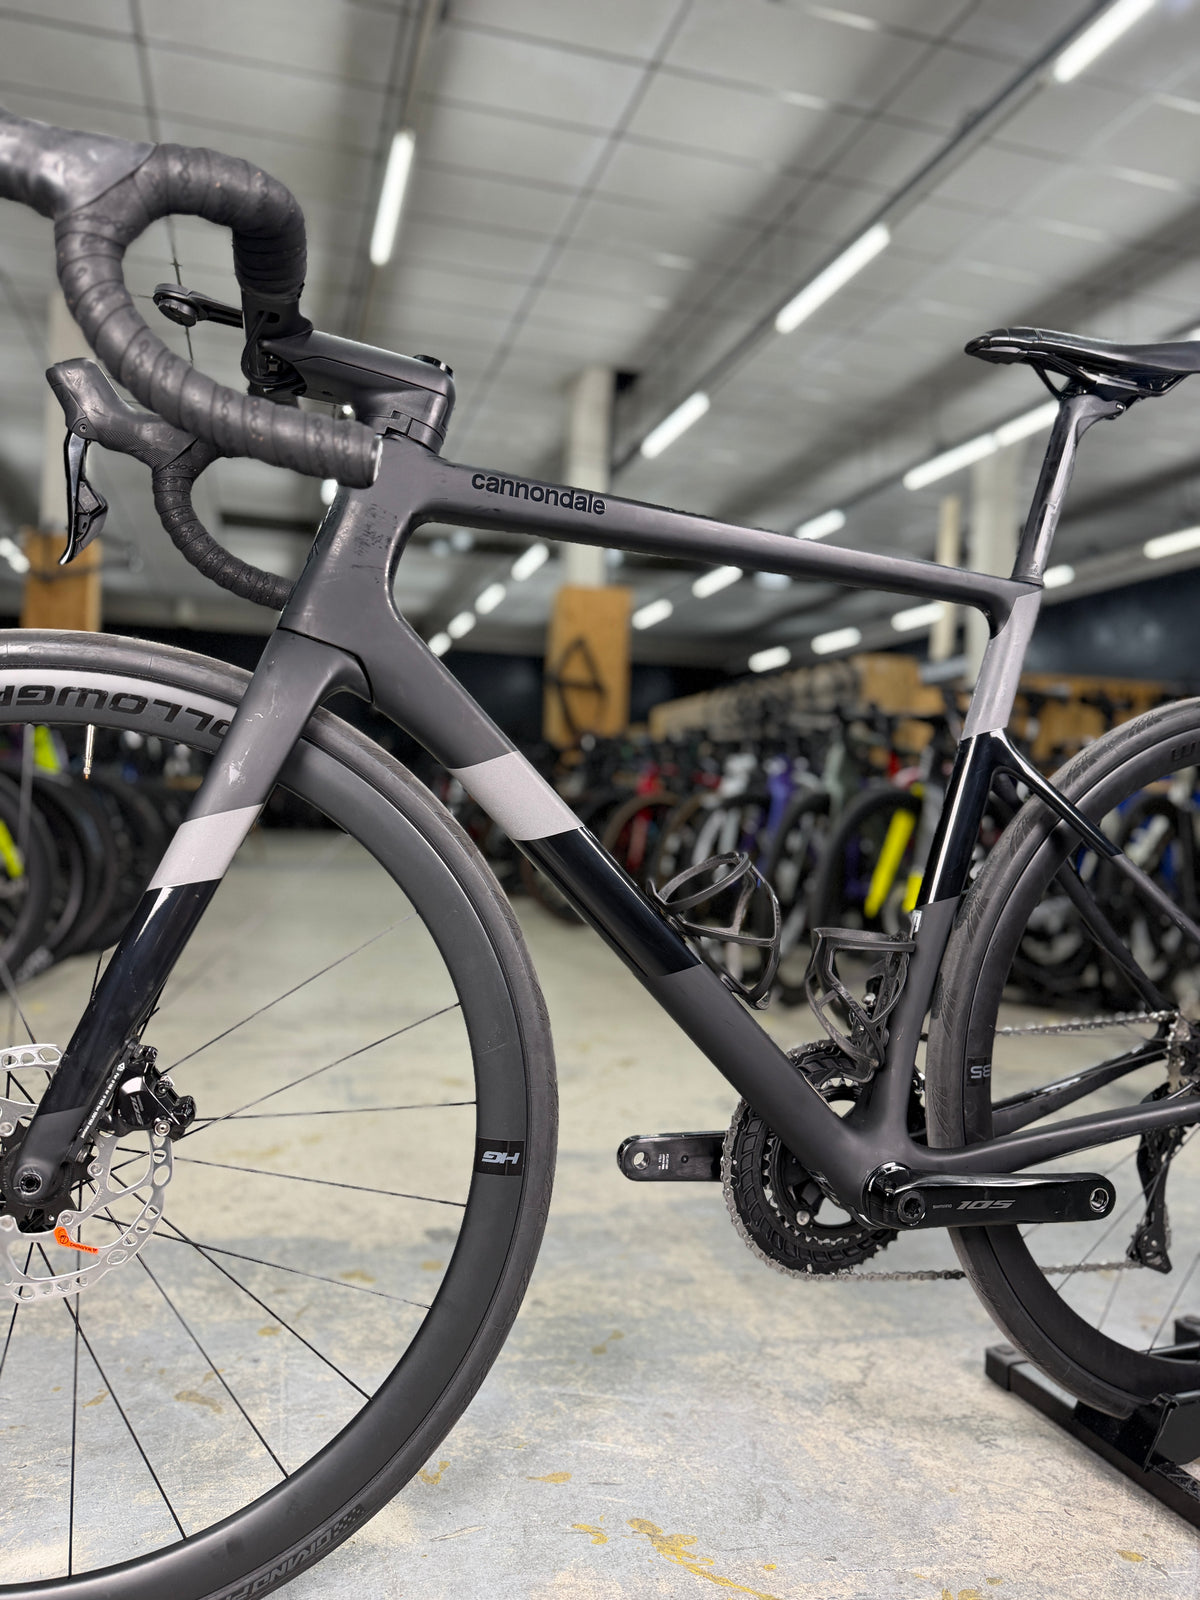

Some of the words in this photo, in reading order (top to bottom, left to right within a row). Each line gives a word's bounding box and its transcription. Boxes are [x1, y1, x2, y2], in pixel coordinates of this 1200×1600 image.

[472, 474, 606, 515] cannondale
[482, 1151, 520, 1164] HG
[956, 1200, 1016, 1210] 105
[251, 1528, 332, 1594] GRAND
